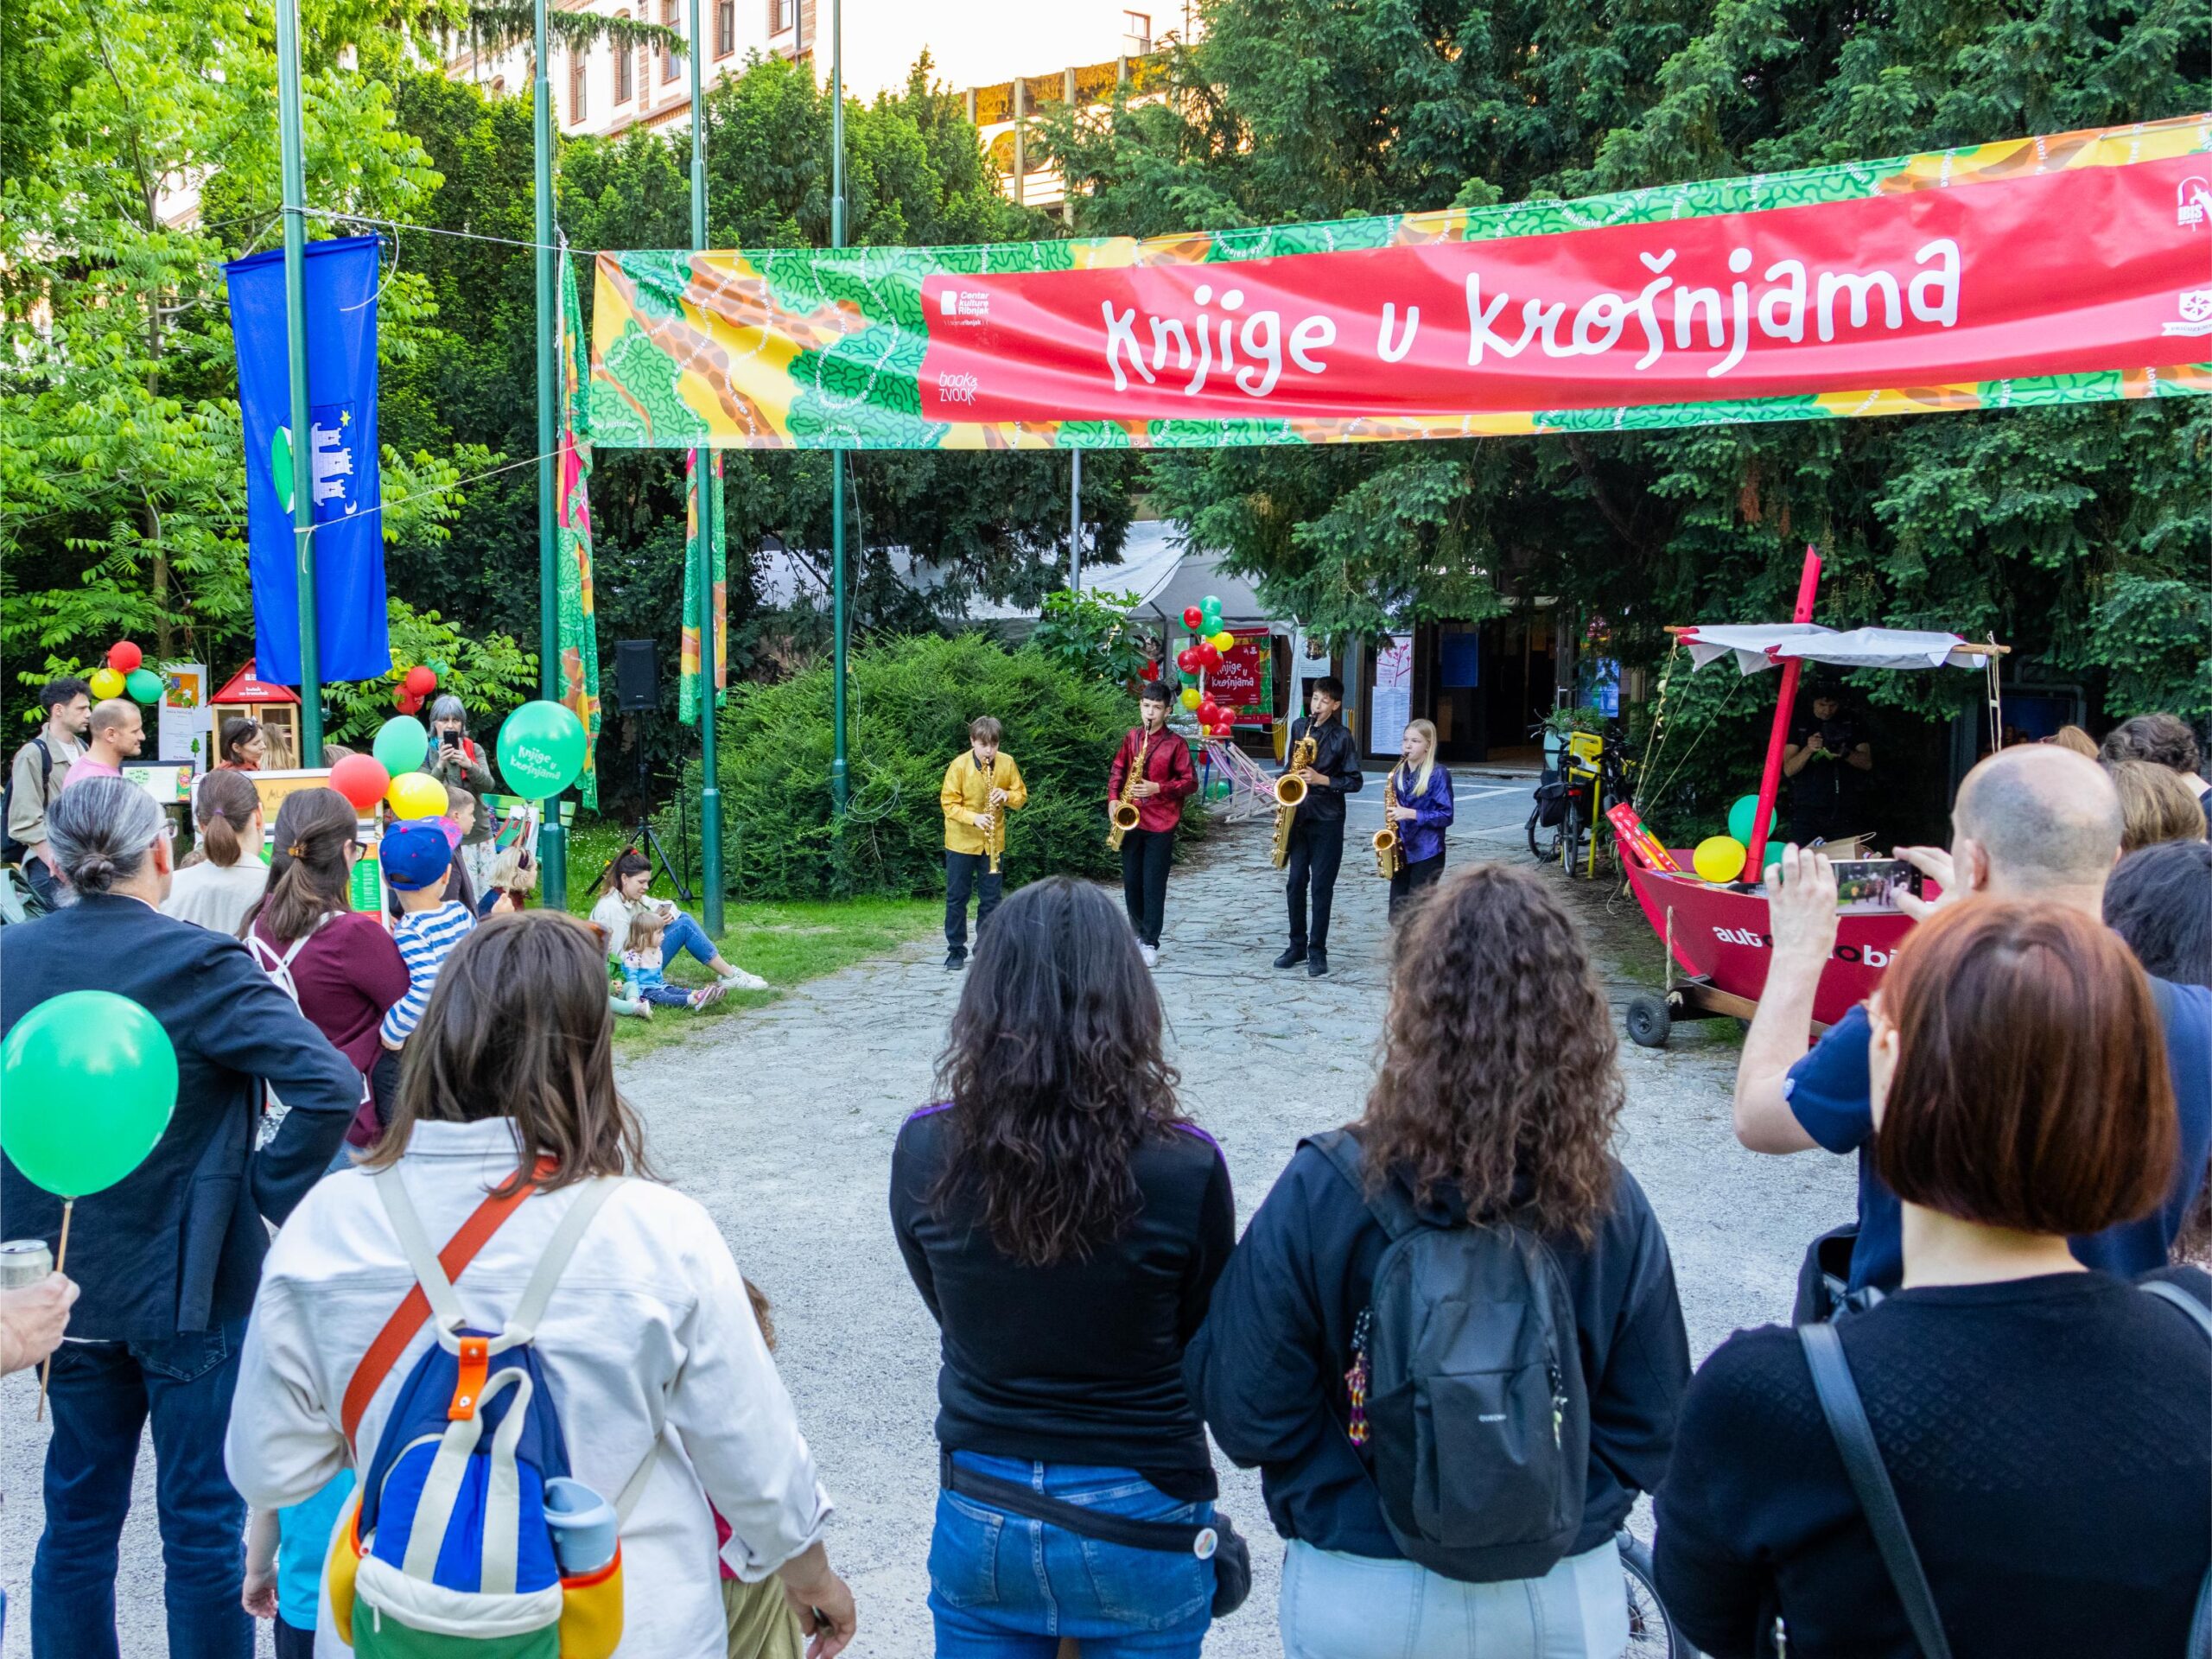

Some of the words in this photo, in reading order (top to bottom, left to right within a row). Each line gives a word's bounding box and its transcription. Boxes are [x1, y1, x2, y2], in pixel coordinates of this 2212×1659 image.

[1101, 284, 1338, 397] Knjige
[1376, 302, 1420, 364] u
[1465, 238, 1961, 378] krošnjama
